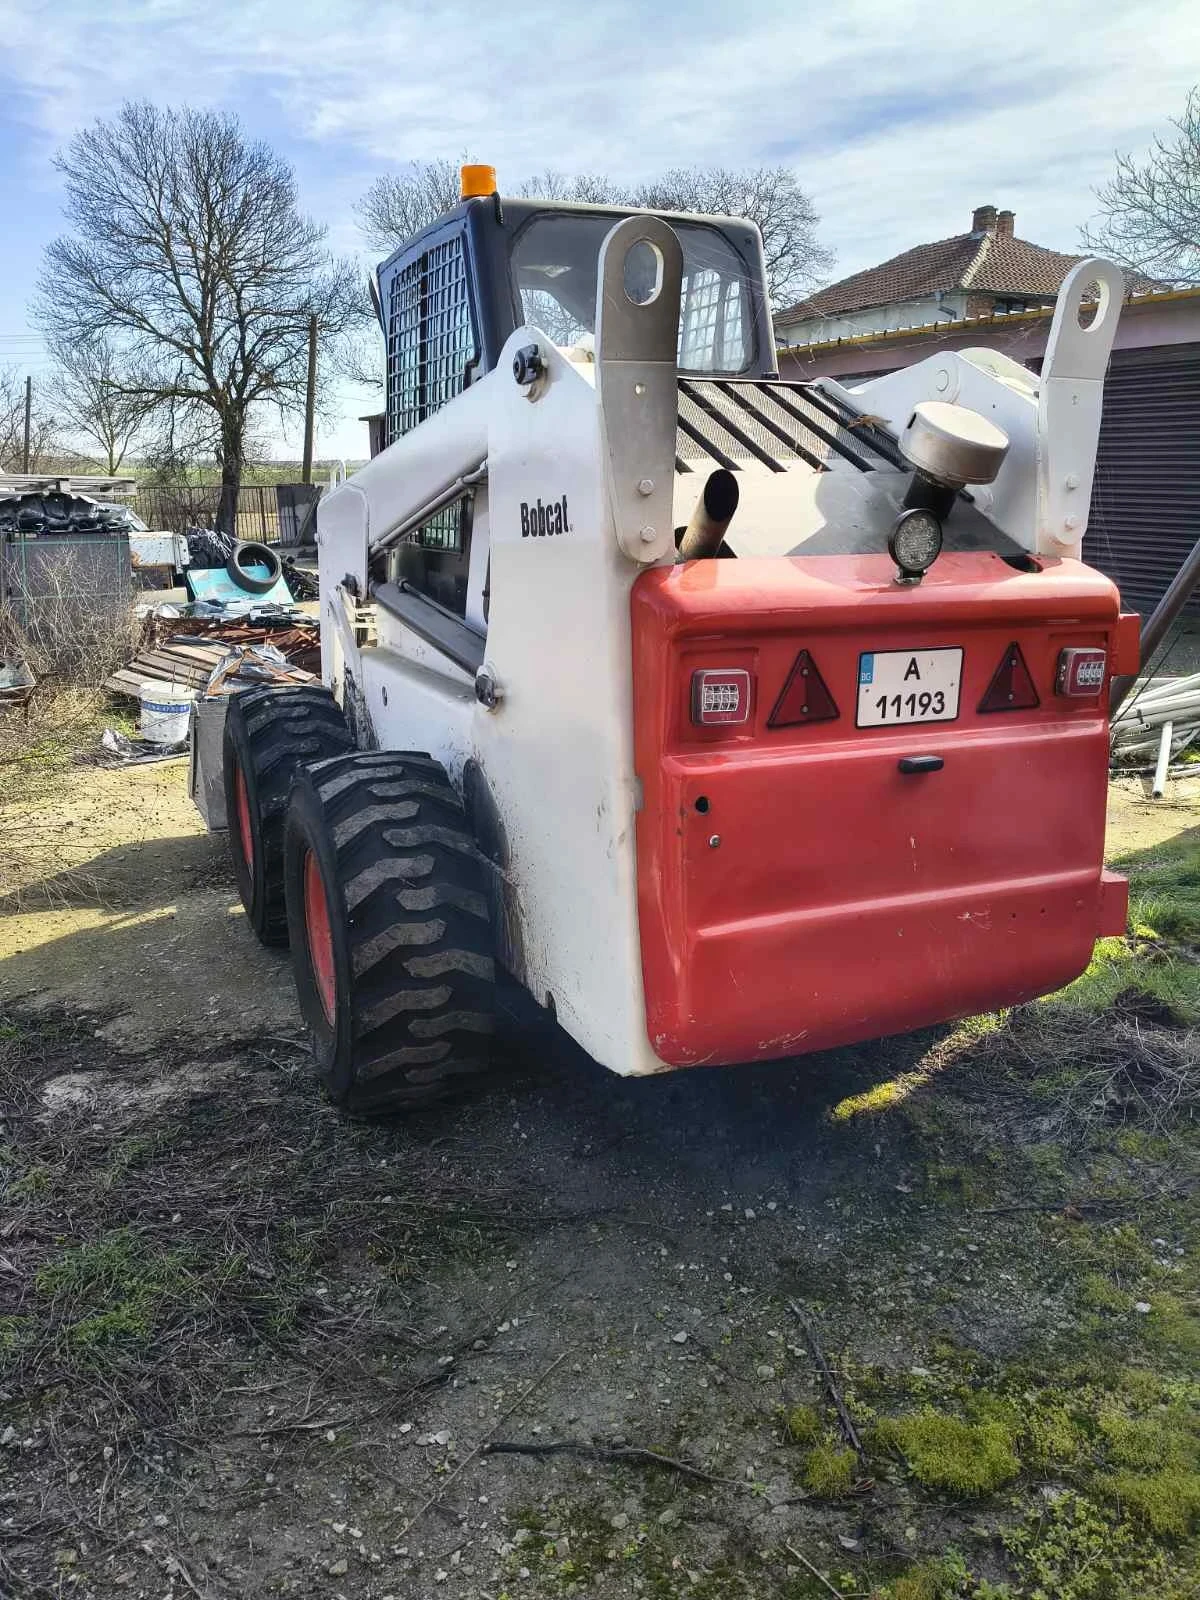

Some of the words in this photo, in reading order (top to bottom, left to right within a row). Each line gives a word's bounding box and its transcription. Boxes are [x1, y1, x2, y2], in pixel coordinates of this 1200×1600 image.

[520, 494, 569, 537] Bobcat
[861, 672, 872, 681] BG
[904, 657, 920, 681] A
[876, 691, 945, 718] 11193
